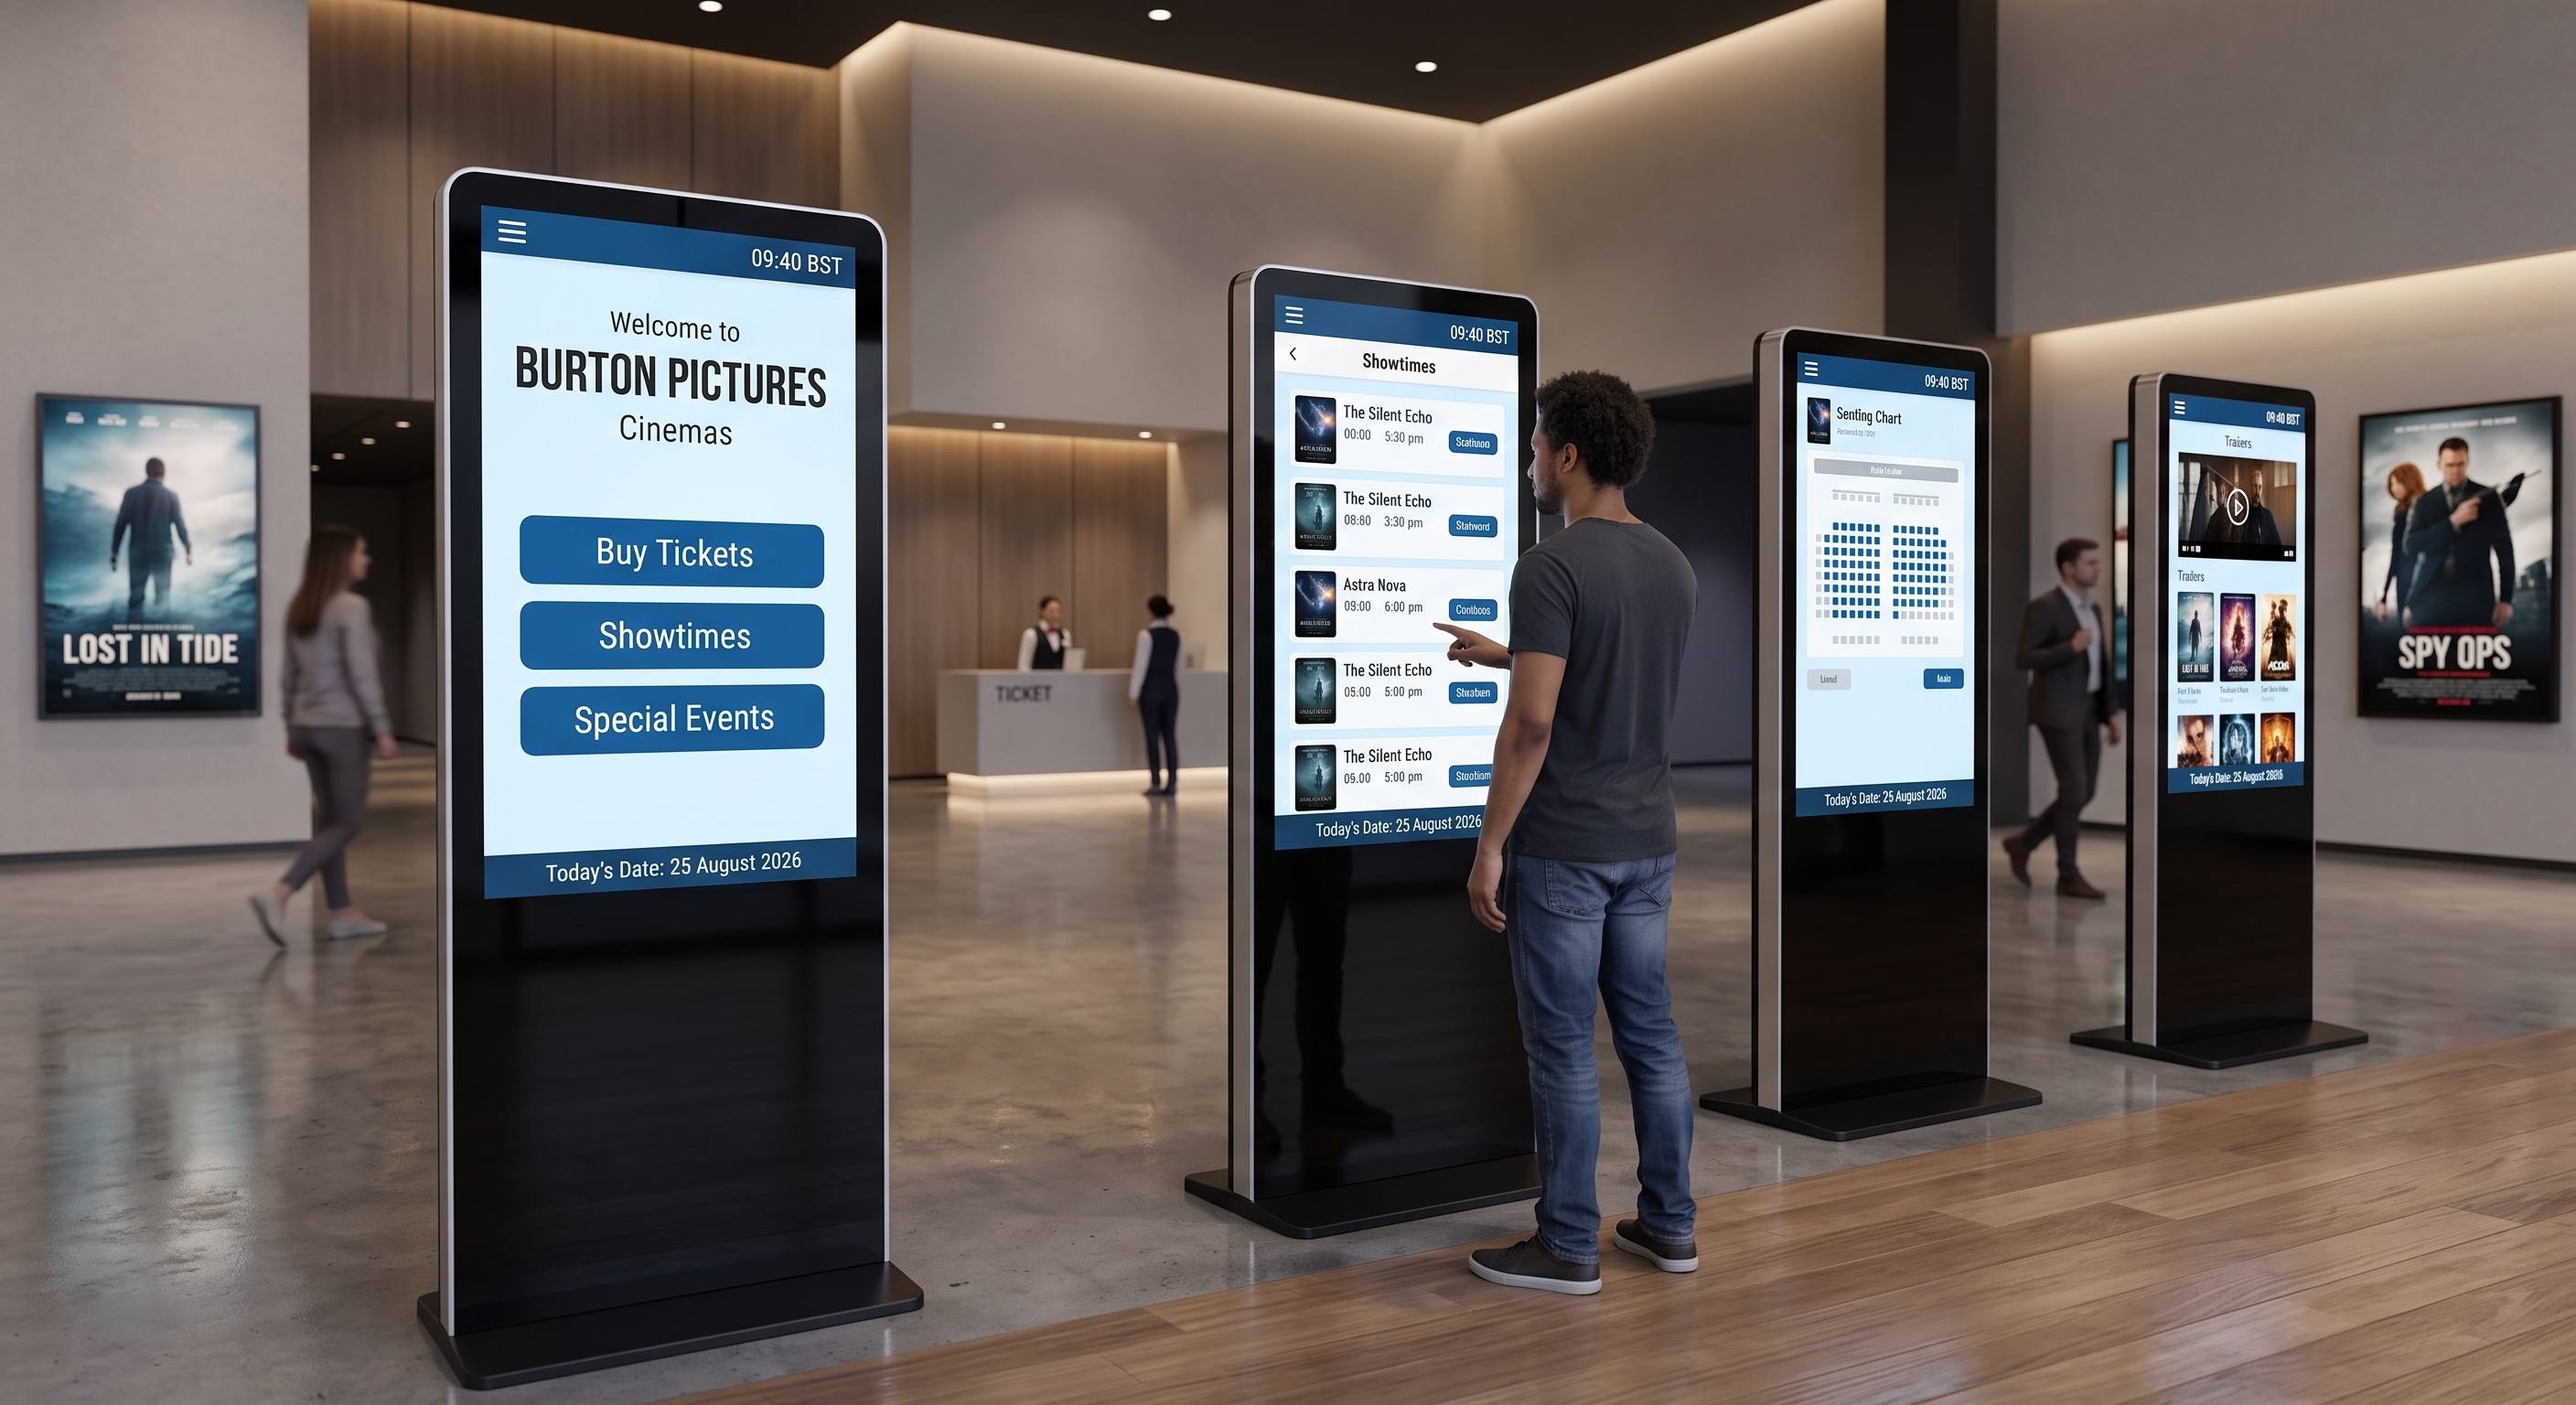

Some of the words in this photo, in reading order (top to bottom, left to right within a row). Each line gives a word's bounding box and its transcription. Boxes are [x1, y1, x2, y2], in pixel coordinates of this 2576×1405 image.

[751, 248, 801, 272] 09:40
[808, 253, 843, 275] BST
[610, 310, 713, 341] Welcome
[718, 321, 740, 343] to
[1450, 324, 1484, 342] 09:40
[1487, 328, 1510, 345] BST
[1363, 352, 1436, 374] Showtimes
[516, 345, 656, 397] BURTON
[669, 357, 827, 408] PICTURES
[1925, 373, 1949, 390] 09:40
[1951, 376, 1970, 391] BST
[1344, 404, 1366, 420] The
[1368, 405, 1402, 423] Silent
[1405, 409, 1433, 424] Echo
[1836, 406, 1873, 426] Senting
[1875, 410, 1902, 425] Chart
[619, 413, 733, 445] Cinemas
[1344, 427, 1371, 441] 00:00
[1385, 430, 1405, 444] 5:30
[1408, 434, 1424, 446] pm
[1344, 490, 1366, 506] The
[1368, 491, 1402, 508] Silent
[1405, 493, 1433, 509] Echo
[1344, 513, 1371, 527] 08:80
[1384, 515, 1405, 528] 3:30
[1408, 519, 1423, 531] pm
[597, 537, 648, 573] Buy
[655, 538, 754, 568] Tickets
[1343, 577, 1375, 592] Astra
[1378, 578, 1406, 593] Nova
[1385, 600, 1405, 613] 6:00
[1408, 604, 1423, 615] pm
[599, 620, 751, 649] Showtimes
[62, 632, 134, 665] LOST
[140, 633, 170, 665] IN
[177, 633, 240, 665] TIDE
[2398, 634, 2453, 670] SPY
[2456, 634, 2512, 670] OPS
[1344, 663, 1366, 677] The
[1368, 662, 1402, 677] Silent
[1405, 662, 1433, 677] Echo
[995, 684, 1053, 702] TICKET
[1385, 685, 1405, 697] 5:00
[1408, 688, 1422, 700] pm
[574, 703, 676, 741] Special
[686, 703, 775, 732] Events
[1344, 748, 1366, 764] The
[1368, 747, 1402, 763] Silent
[1405, 746, 1433, 762] Echo
[1385, 771, 1405, 783] 5:00
[1408, 772, 1422, 785] pm
[1824, 792, 1857, 810] Today's
[1860, 790, 1881, 804] Date:
[1883, 789, 1894, 803] 25
[1895, 789, 1926, 806] August
[1927, 787, 1948, 800] 2026
[1315, 820, 1360, 840] Today's
[1363, 820, 1393, 834] Date:
[1396, 818, 1411, 832] 25
[1413, 816, 1453, 834] August
[1454, 813, 1482, 830] 2026
[546, 861, 614, 885] Today's
[620, 859, 665, 879] Date:
[671, 857, 692, 875] 25
[696, 854, 757, 877] August
[761, 851, 802, 870] 2026
